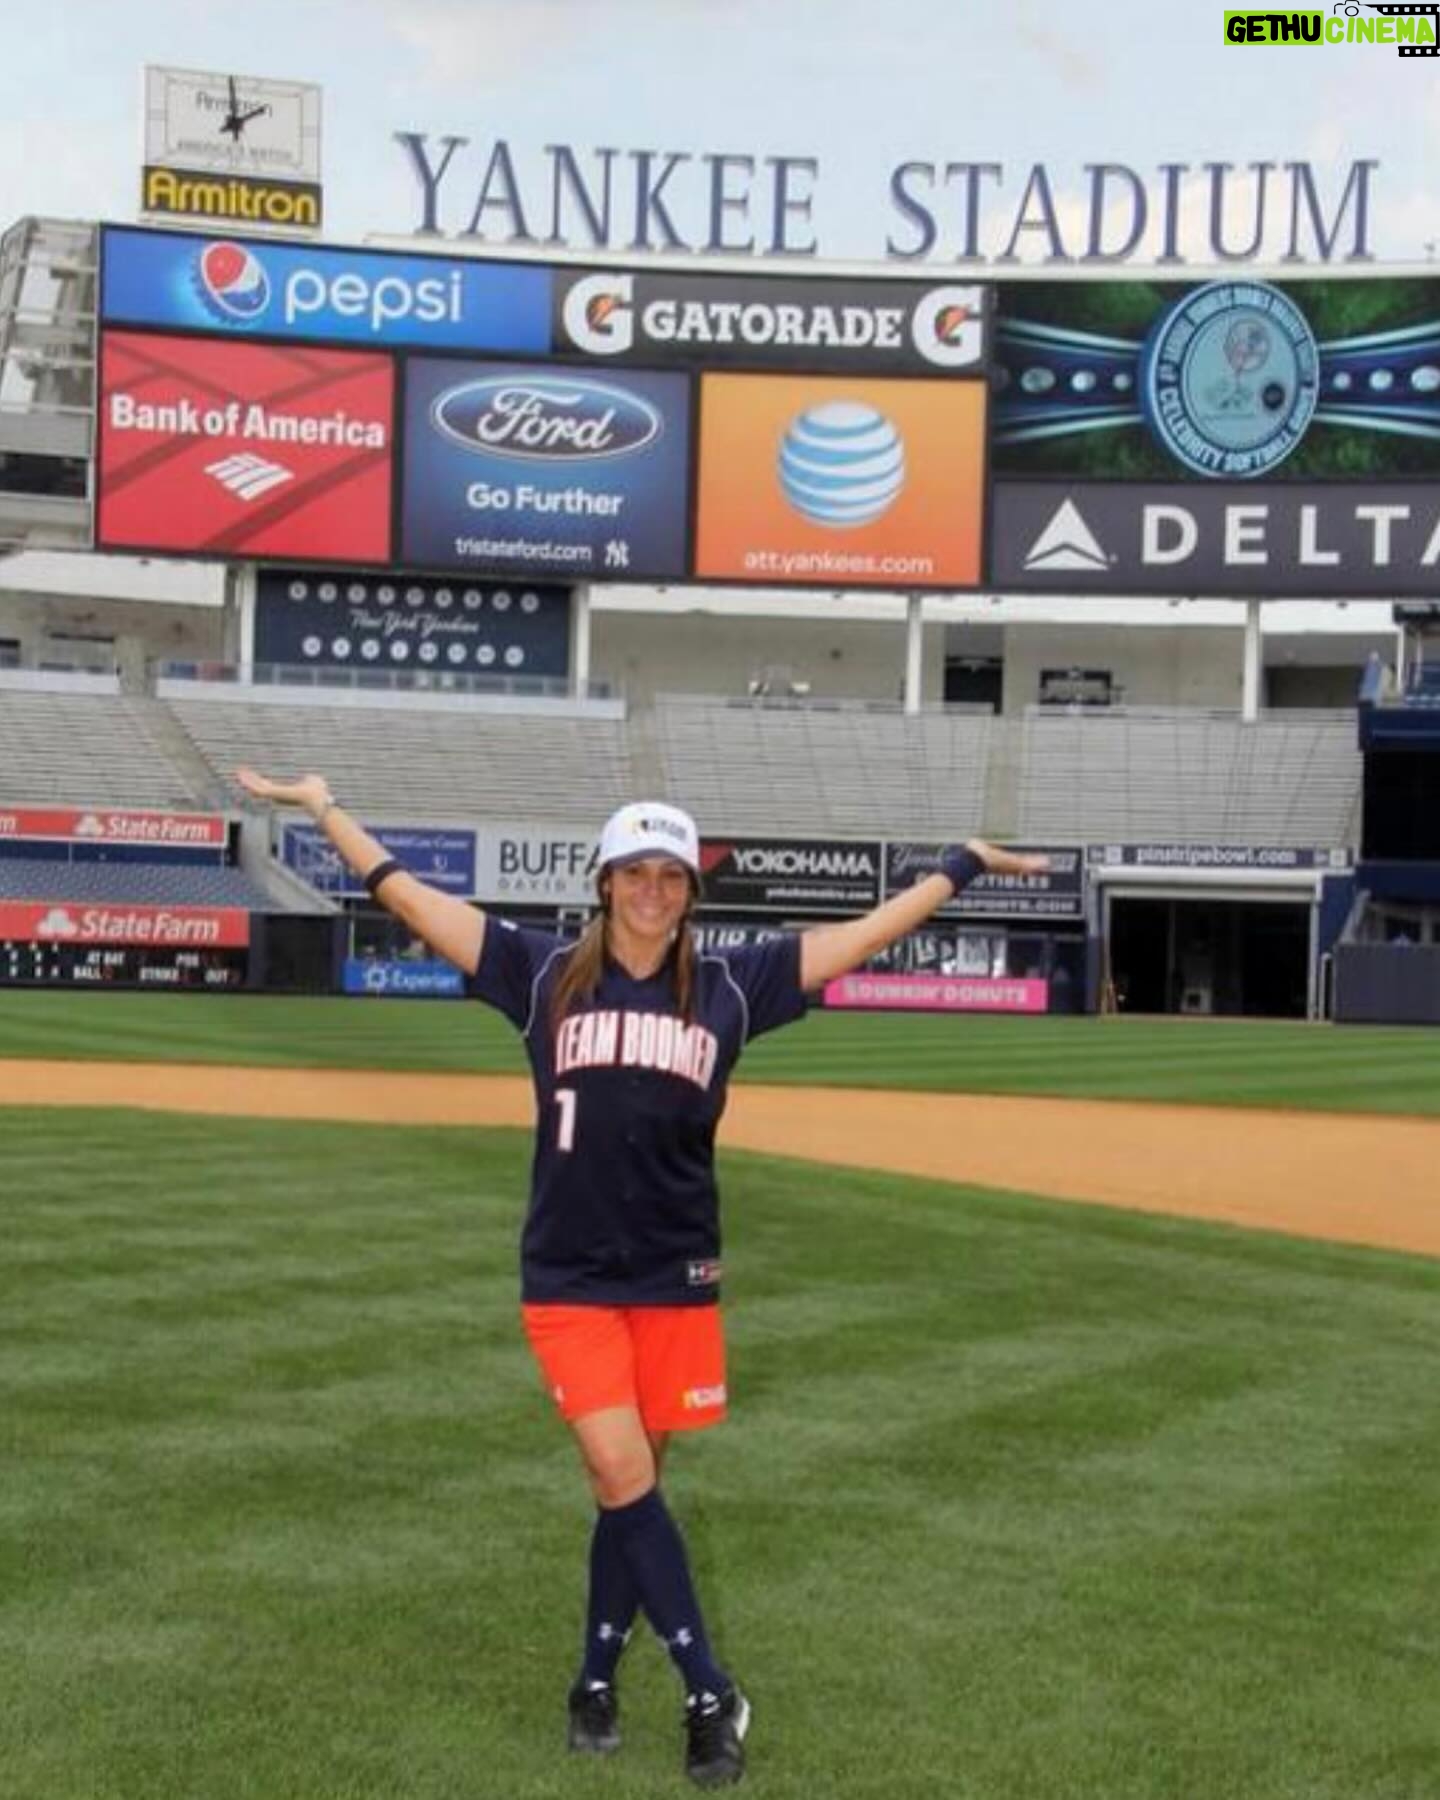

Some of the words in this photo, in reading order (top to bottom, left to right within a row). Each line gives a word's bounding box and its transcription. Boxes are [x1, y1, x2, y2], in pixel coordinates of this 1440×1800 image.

[149, 169, 317, 223] Armitron
[393, 131, 819, 257] YANKEE
[886, 158, 1379, 265] STADIUM
[285, 270, 462, 331] pepsi
[643, 300, 902, 348] GATORADE
[110, 393, 199, 433] Bank
[203, 402, 240, 436] of
[243, 404, 385, 447] America
[477, 387, 616, 449] Ford
[467, 482, 510, 509] Go
[515, 485, 622, 515] Further
[455, 537, 592, 562] tristateford.com
[745, 552, 933, 574] att.yankees.com
[107, 815, 161, 838] State
[161, 818, 211, 841] Farm
[499, 840, 601, 876] BUFF
[731, 847, 874, 876] YOKOHAMA
[1136, 846, 1298, 866] pinstripebowl.com
[81, 908, 151, 938] State
[152, 911, 220, 941] Farm
[556, 1010, 619, 1075] TEAM
[554, 1088, 577, 1153] 1
